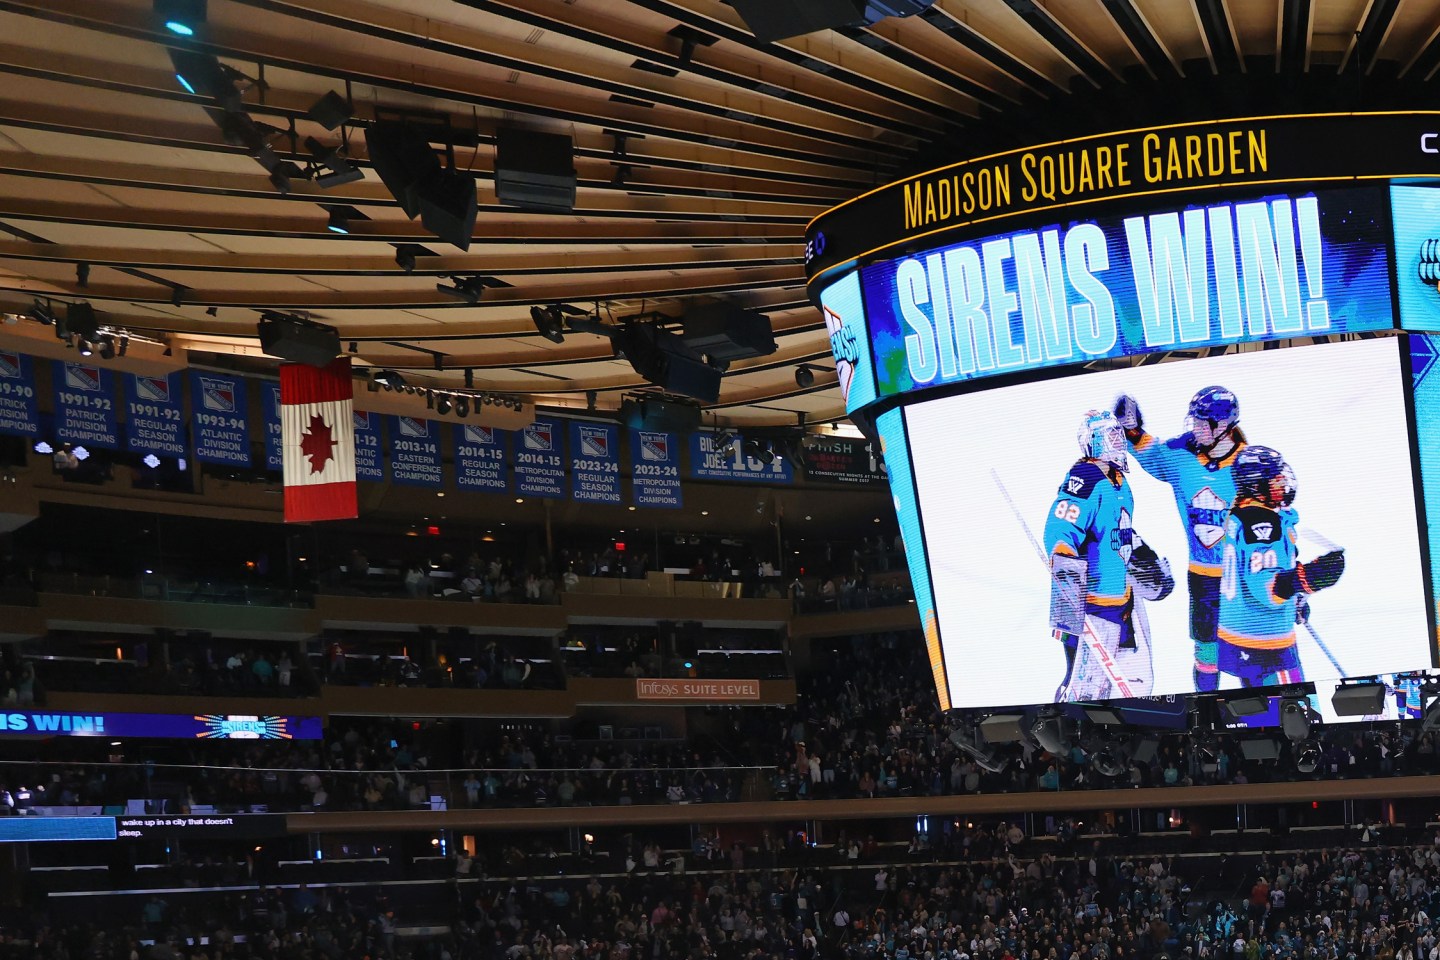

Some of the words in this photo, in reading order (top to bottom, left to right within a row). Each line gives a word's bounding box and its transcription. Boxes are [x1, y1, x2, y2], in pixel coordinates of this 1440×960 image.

[903, 165, 1012, 232] MADISON
[1021, 144, 1133, 204] SQUARE
[1142, 127, 1270, 185] GARDEN
[895, 217, 1121, 385] SIRENS
[1122, 193, 1332, 341] WIN!
[59, 392, 111, 411] 1991-92
[65, 409, 107, 423] PATRICK
[129, 402, 181, 421] 1991-92
[66, 419, 108, 433] DIVISION
[134, 418, 178, 433] REGULAR
[196, 413, 246, 431] 1993-94
[58, 428, 116, 444] CHAMPIONS
[138, 429, 176, 442] SEASON
[201, 428, 243, 442] ATLANTIC
[130, 438, 184, 453] CHAMPIONS
[203, 439, 241, 451] DIVISION
[394, 440, 437, 454] 2013-14
[197, 448, 249, 462] CHAMPIONS
[398, 453, 435, 465] EASTERN
[458, 446, 503, 460] 2014-15
[517, 453, 561, 466] 2014-15
[391, 461, 442, 474] CONFERENCE
[462, 459, 500, 470] REGULAR
[573, 459, 619, 473] 2023-24
[634, 464, 678, 477] 2023-24
[394, 471, 441, 483] CHAMPIONS
[465, 468, 498, 479] SEASON
[514, 466, 565, 478] METROPOLITAN
[578, 473, 615, 484] REGULAR
[458, 476, 506, 488] CHAMPIONS
[526, 475, 555, 485] DIVISION
[633, 478, 681, 487] METROPOLITAN
[520, 484, 561, 494] CHAMPIONS
[581, 482, 613, 493] SEASON
[643, 487, 672, 495] DIVISION
[574, 490, 621, 502] CHAMPIONS
[638, 495, 678, 504] CHAMPIONS
[1054, 499, 1081, 524] 82
[640, 682, 678, 697] Infosys
[683, 684, 717, 696] SUITE
[720, 683, 756, 696] LEVEL
[32, 714, 105, 733] WIN!
[121, 818, 143, 827] wake
[144, 819, 155, 828] up
[156, 818, 164, 826] in
[172, 818, 187, 828] city
[188, 818, 204, 826] that
[119, 828, 143, 839] sleep.
